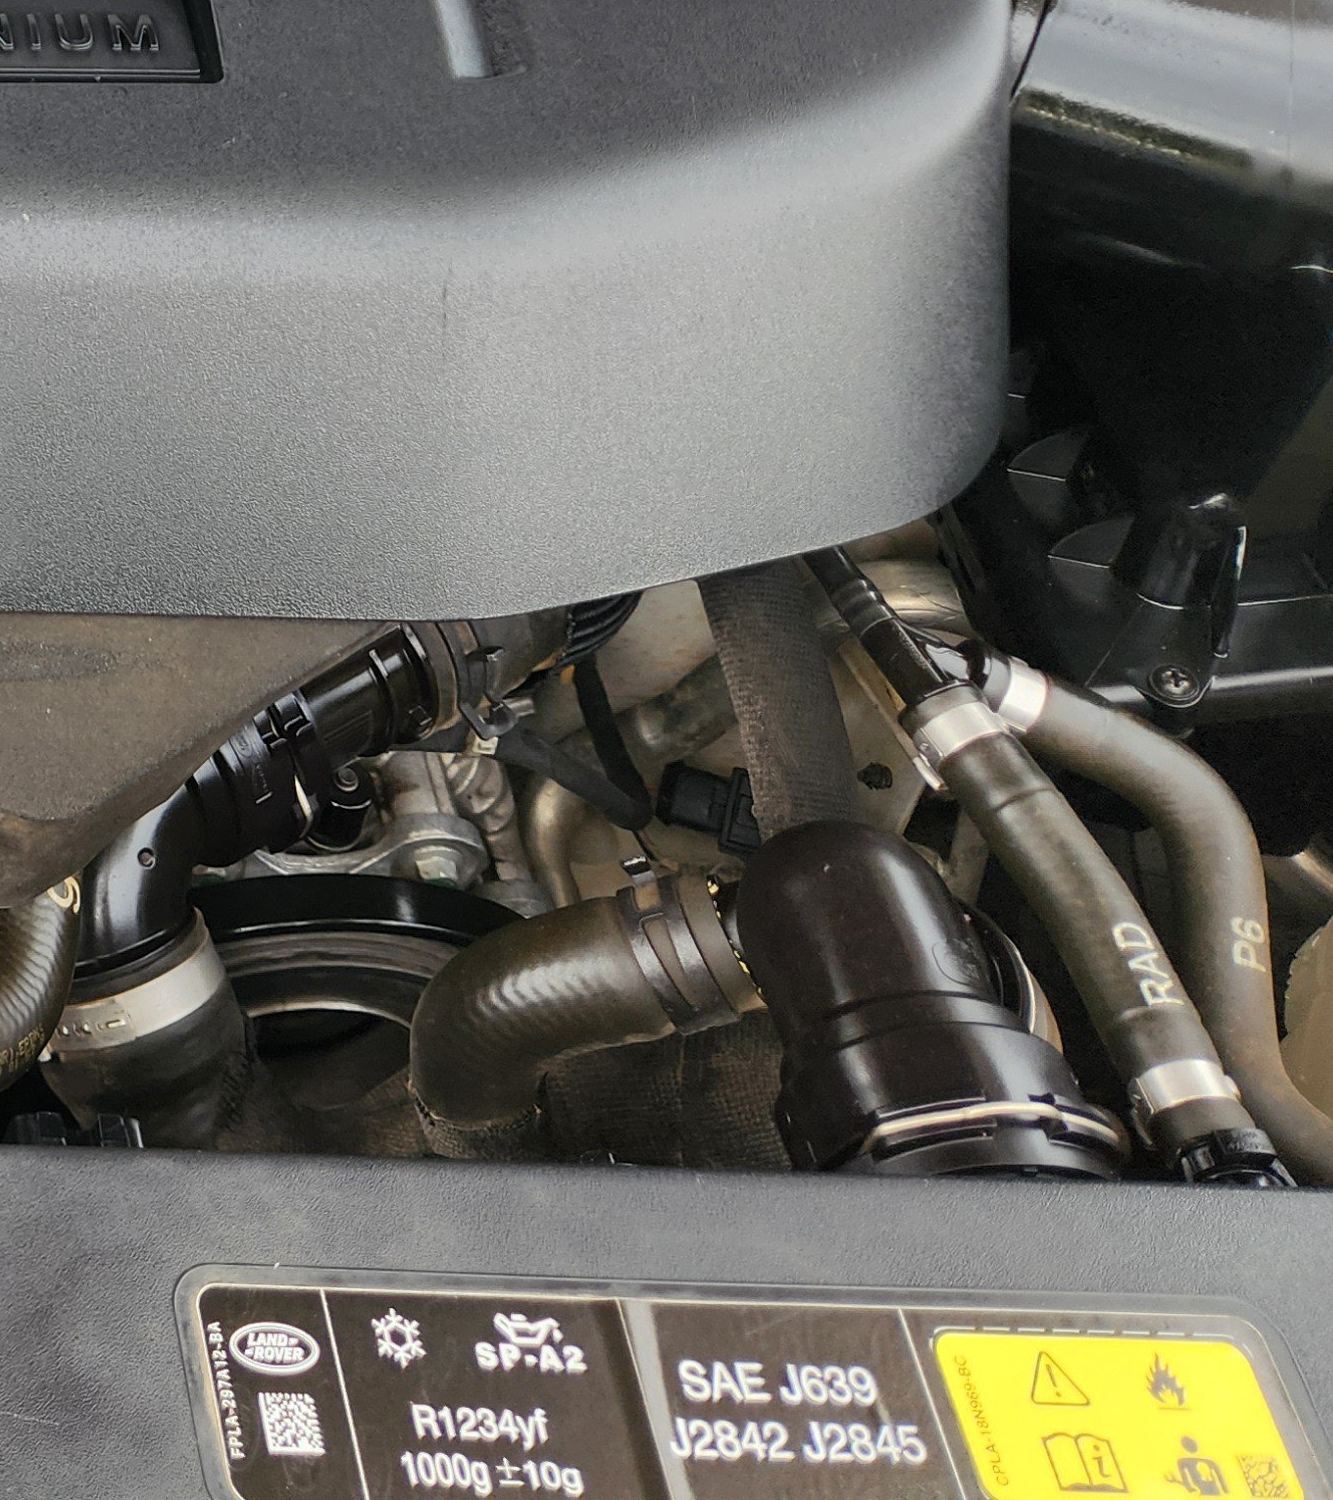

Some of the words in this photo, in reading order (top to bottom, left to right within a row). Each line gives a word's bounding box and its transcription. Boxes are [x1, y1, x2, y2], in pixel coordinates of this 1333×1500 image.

[1111, 922, 1185, 1007] RAD
[1230, 916, 1268, 972] P6
[247, 1332, 289, 1347] LAND
[253, 1345, 305, 1364] ROVER
[475, 1342, 588, 1374] SP-A2
[206, 1321, 246, 1461] FPLA-297A12-BA
[677, 1359, 772, 1404] SAE
[779, 1363, 878, 1406] J639
[410, 1403, 549, 1452] R1234yf
[669, 1416, 796, 1461] J2842
[802, 1420, 928, 1465] J2845
[400, 1450, 494, 1498] 1000g
